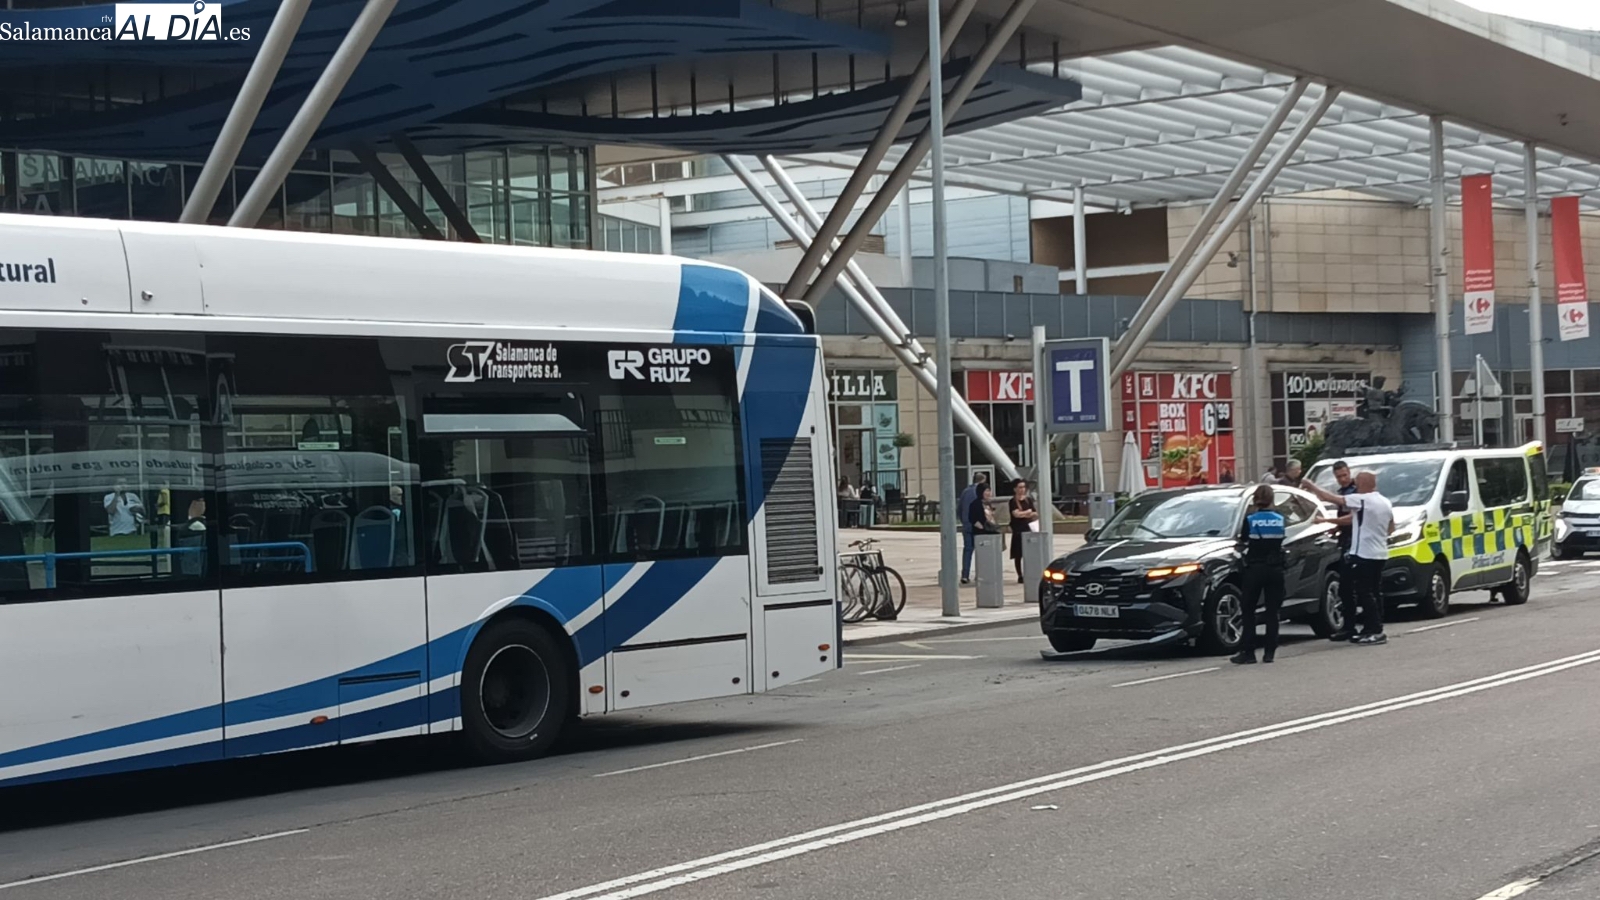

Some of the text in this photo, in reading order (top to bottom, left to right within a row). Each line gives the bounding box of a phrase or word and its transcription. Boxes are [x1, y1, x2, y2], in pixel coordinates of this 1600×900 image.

[23, 156, 175, 187] SALAMANCA
[496, 343, 557, 362] Salamanca de
[648, 348, 711, 365] GRUPO
[487, 360, 542, 383] Transportes
[650, 367, 691, 383] RUIZ
[826, 375, 887, 396] ILLA
[997, 372, 1034, 399] KF
[1055, 360, 1095, 412] T
[1171, 373, 1217, 399] KFC
[1160, 403, 1186, 418] BOX
